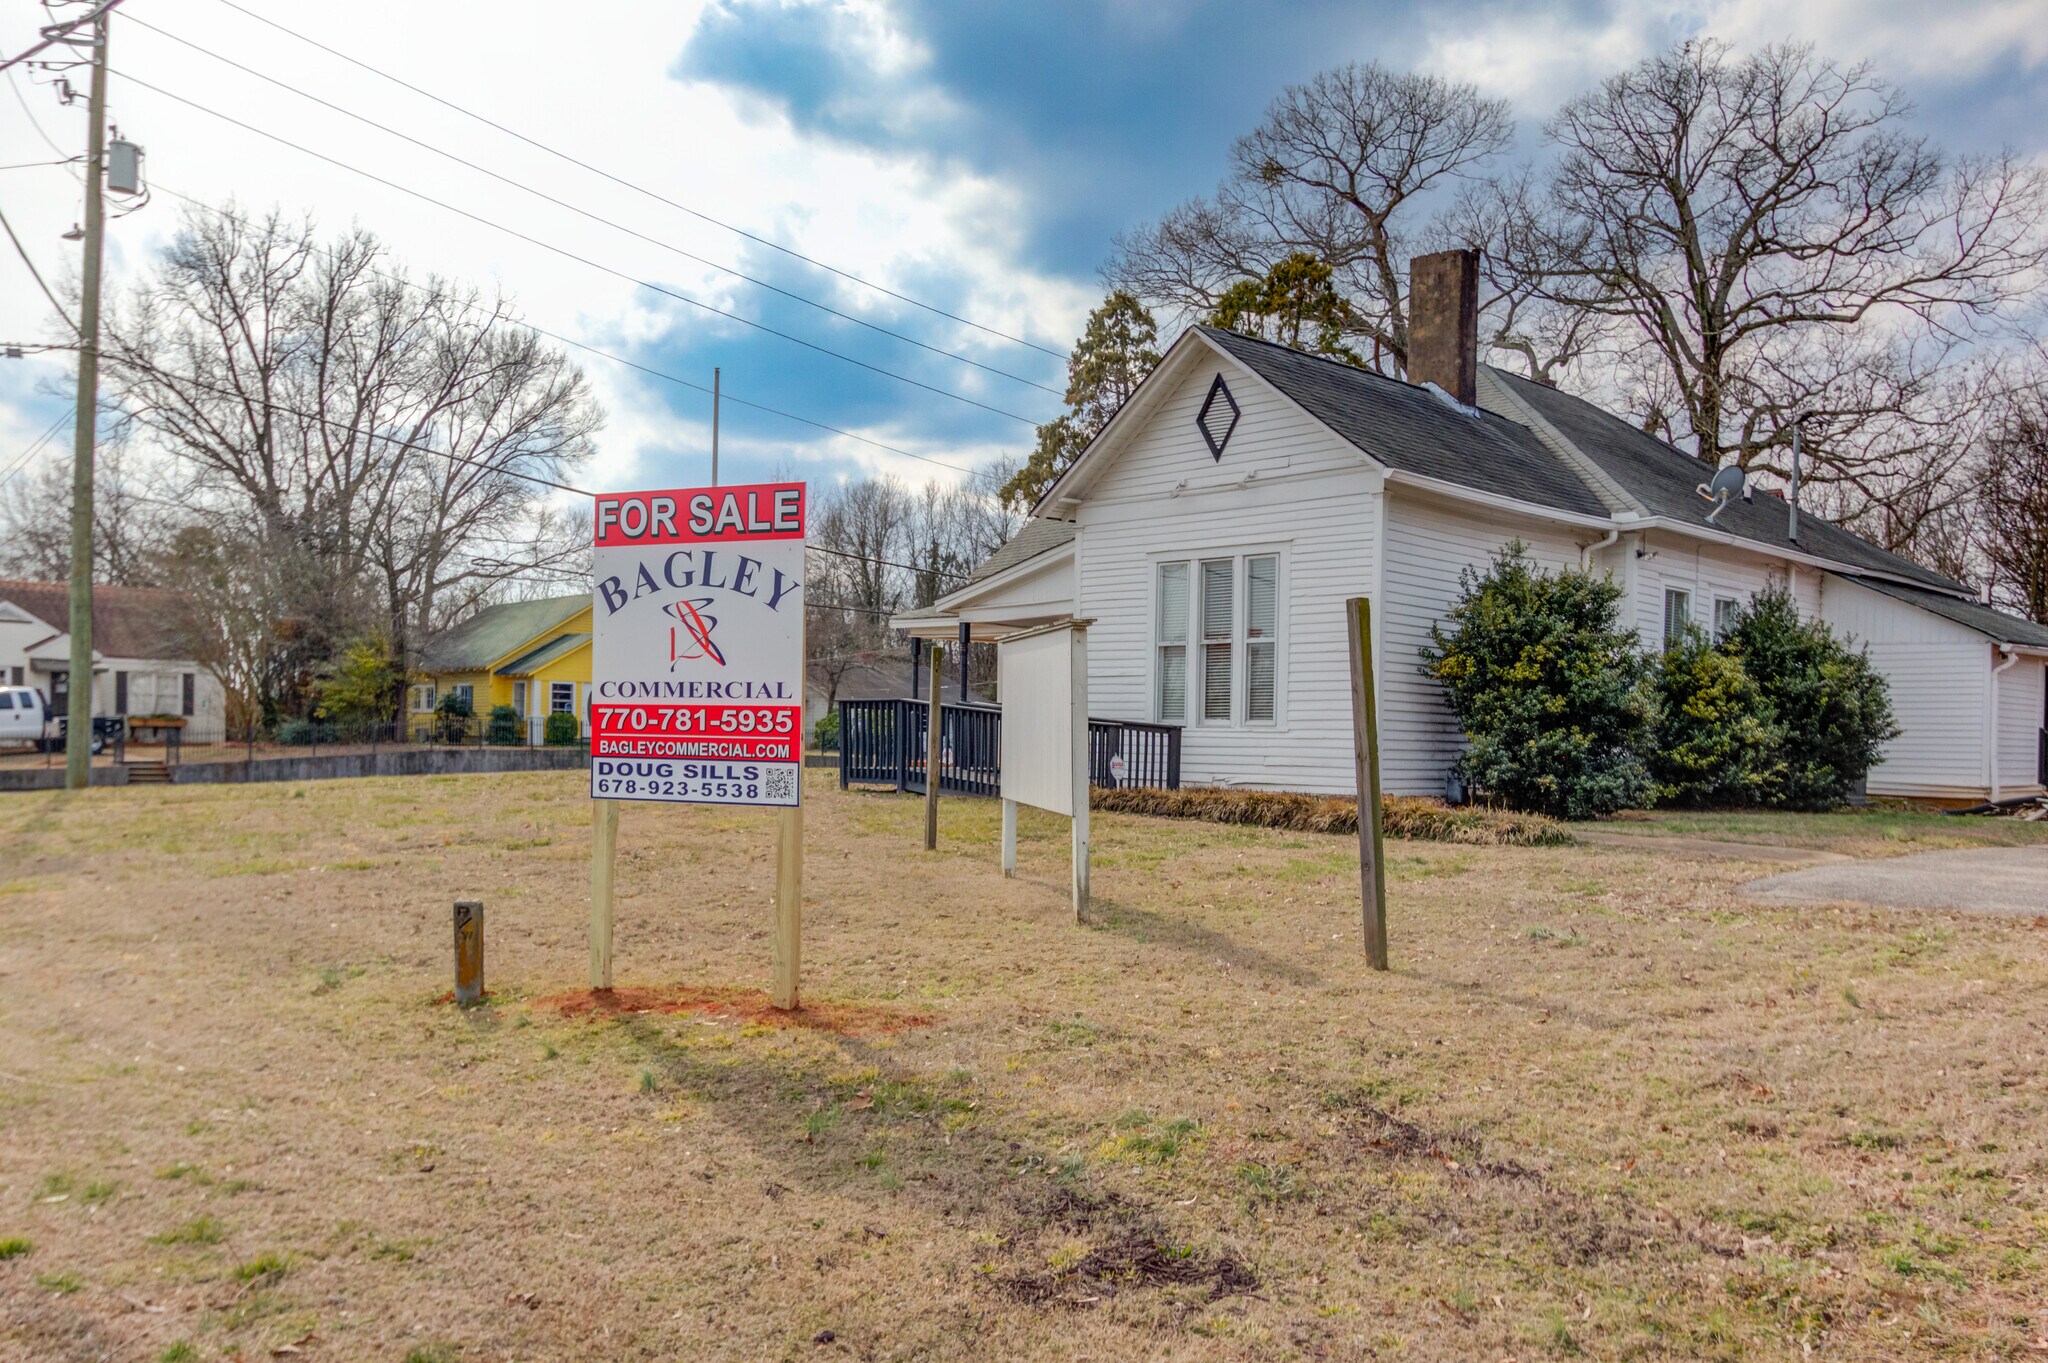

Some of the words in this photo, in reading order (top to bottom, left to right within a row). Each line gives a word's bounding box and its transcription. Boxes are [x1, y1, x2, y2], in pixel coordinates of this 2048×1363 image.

[598, 497, 679, 540] FOR
[688, 489, 800, 536] SALE
[596, 550, 801, 617] BAGLEY
[600, 680, 793, 699] COMMERCIAL
[598, 708, 793, 734] 770-781-5935
[600, 740, 790, 759] BAGLEYCOMMERCIAL.COM
[599, 762, 674, 778] DOUG
[683, 765, 759, 781] SILLS
[598, 779, 759, 799] 678-923-5538
